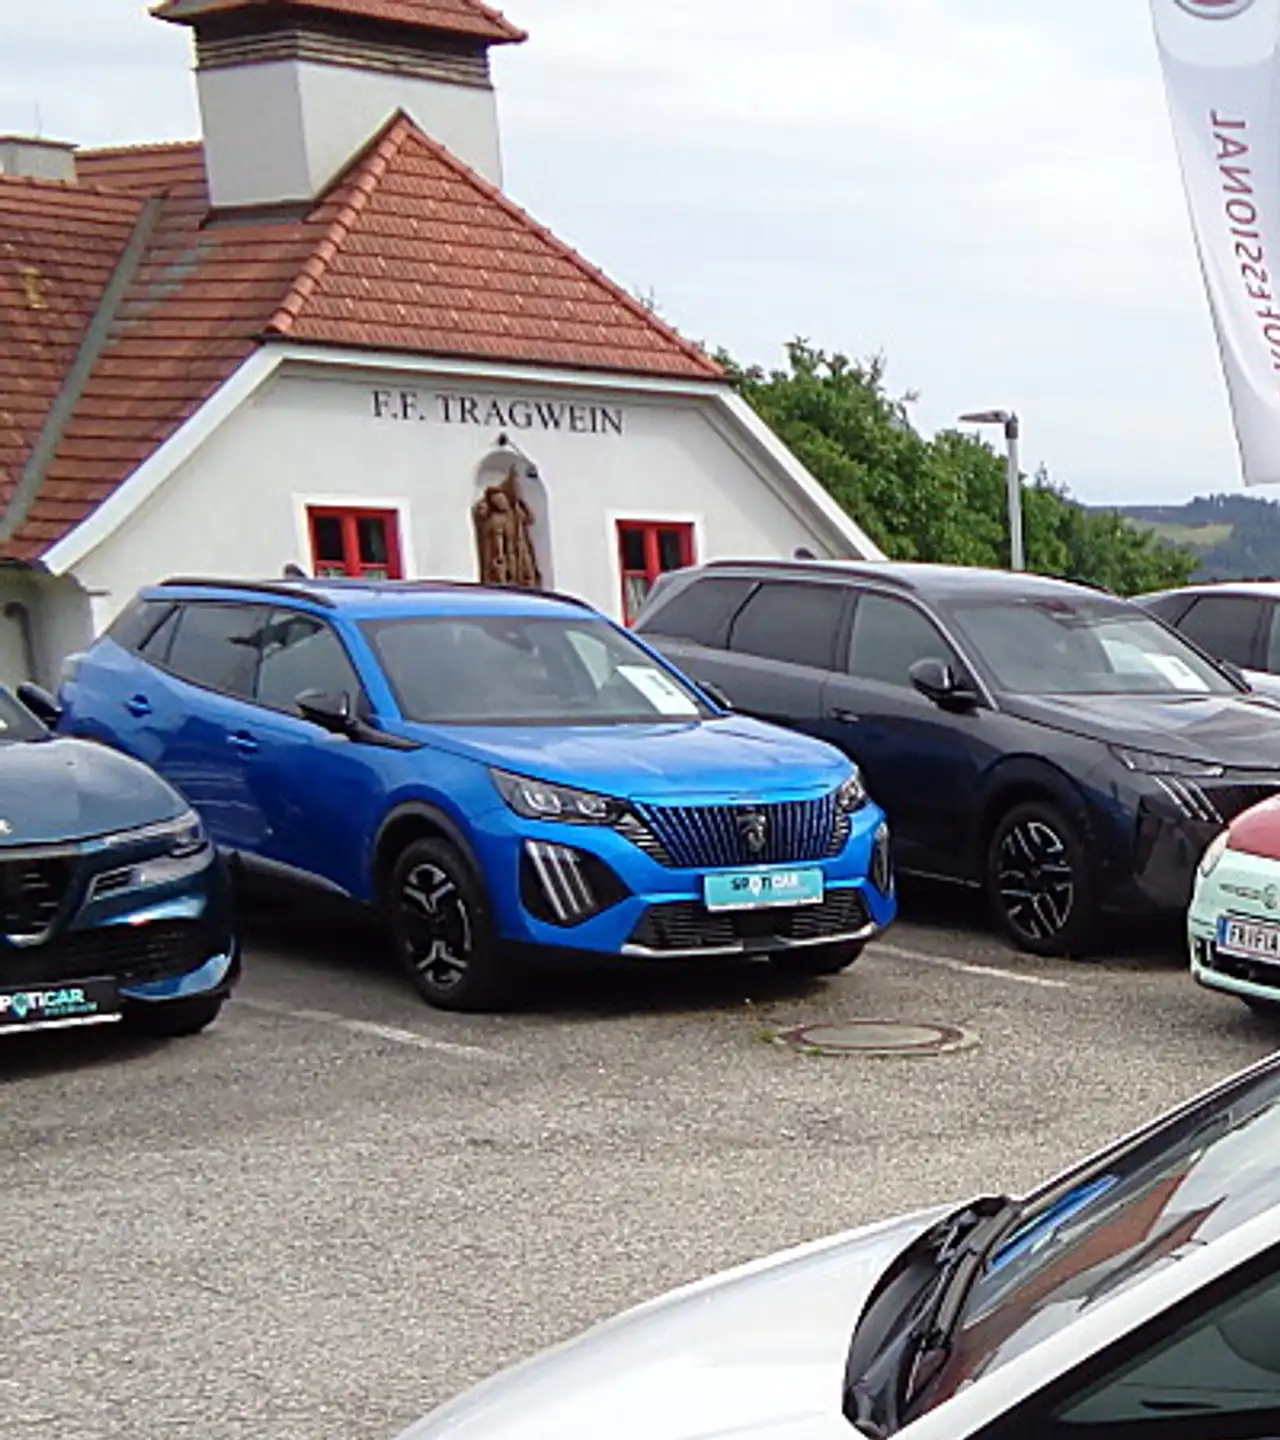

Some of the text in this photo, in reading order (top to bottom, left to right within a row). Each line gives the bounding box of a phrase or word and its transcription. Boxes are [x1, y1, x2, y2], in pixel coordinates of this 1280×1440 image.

[373, 390, 623, 435] F.F. TRAGWEIN
[0, 988, 86, 1016] POTICAR
